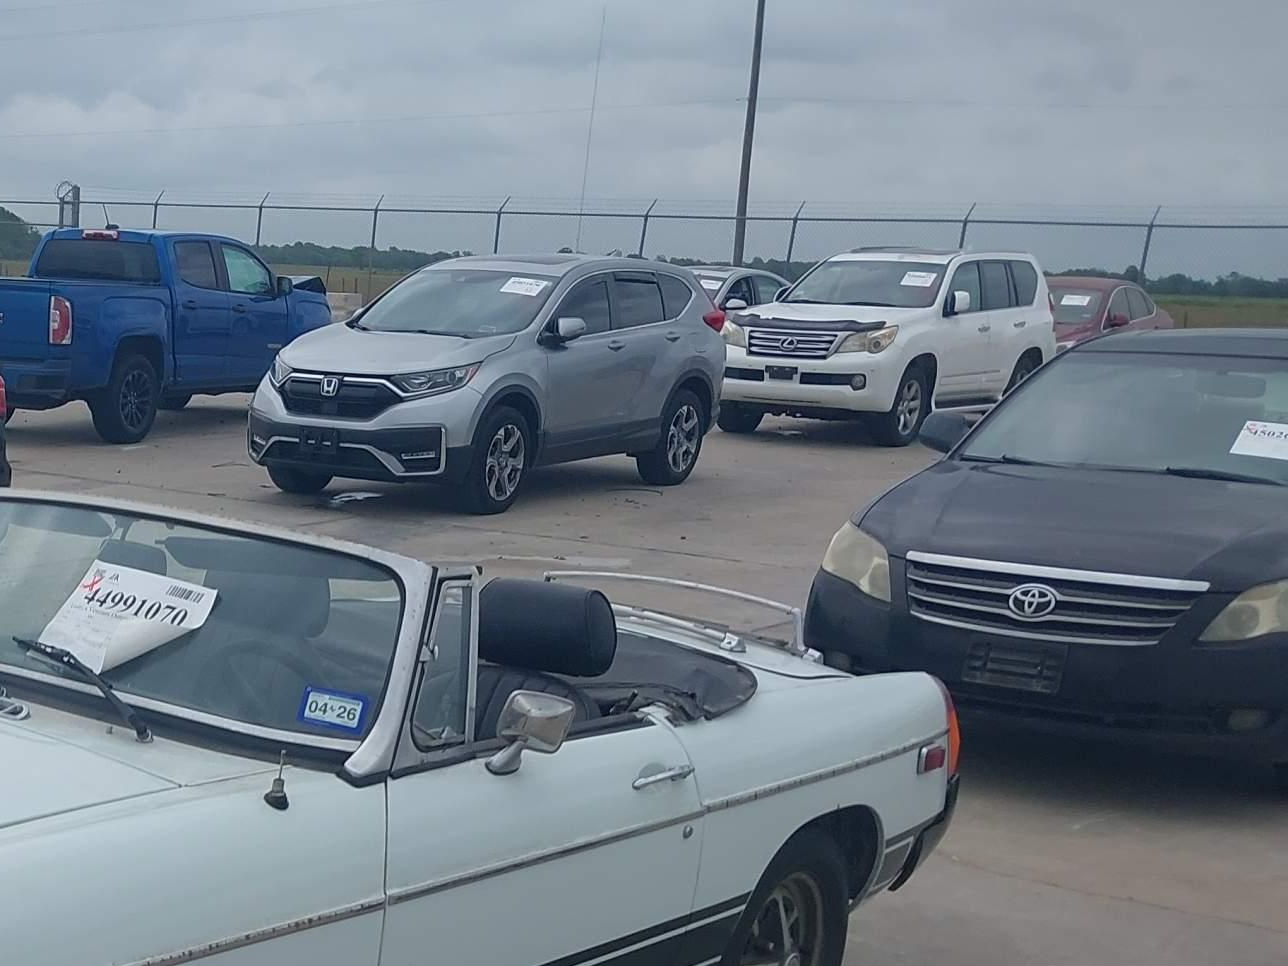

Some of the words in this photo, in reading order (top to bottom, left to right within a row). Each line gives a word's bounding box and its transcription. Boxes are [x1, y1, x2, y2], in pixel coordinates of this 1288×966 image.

[84, 587, 189, 626] 44991070
[308, 700, 329, 716] 04
[336, 705, 358, 721] 26
